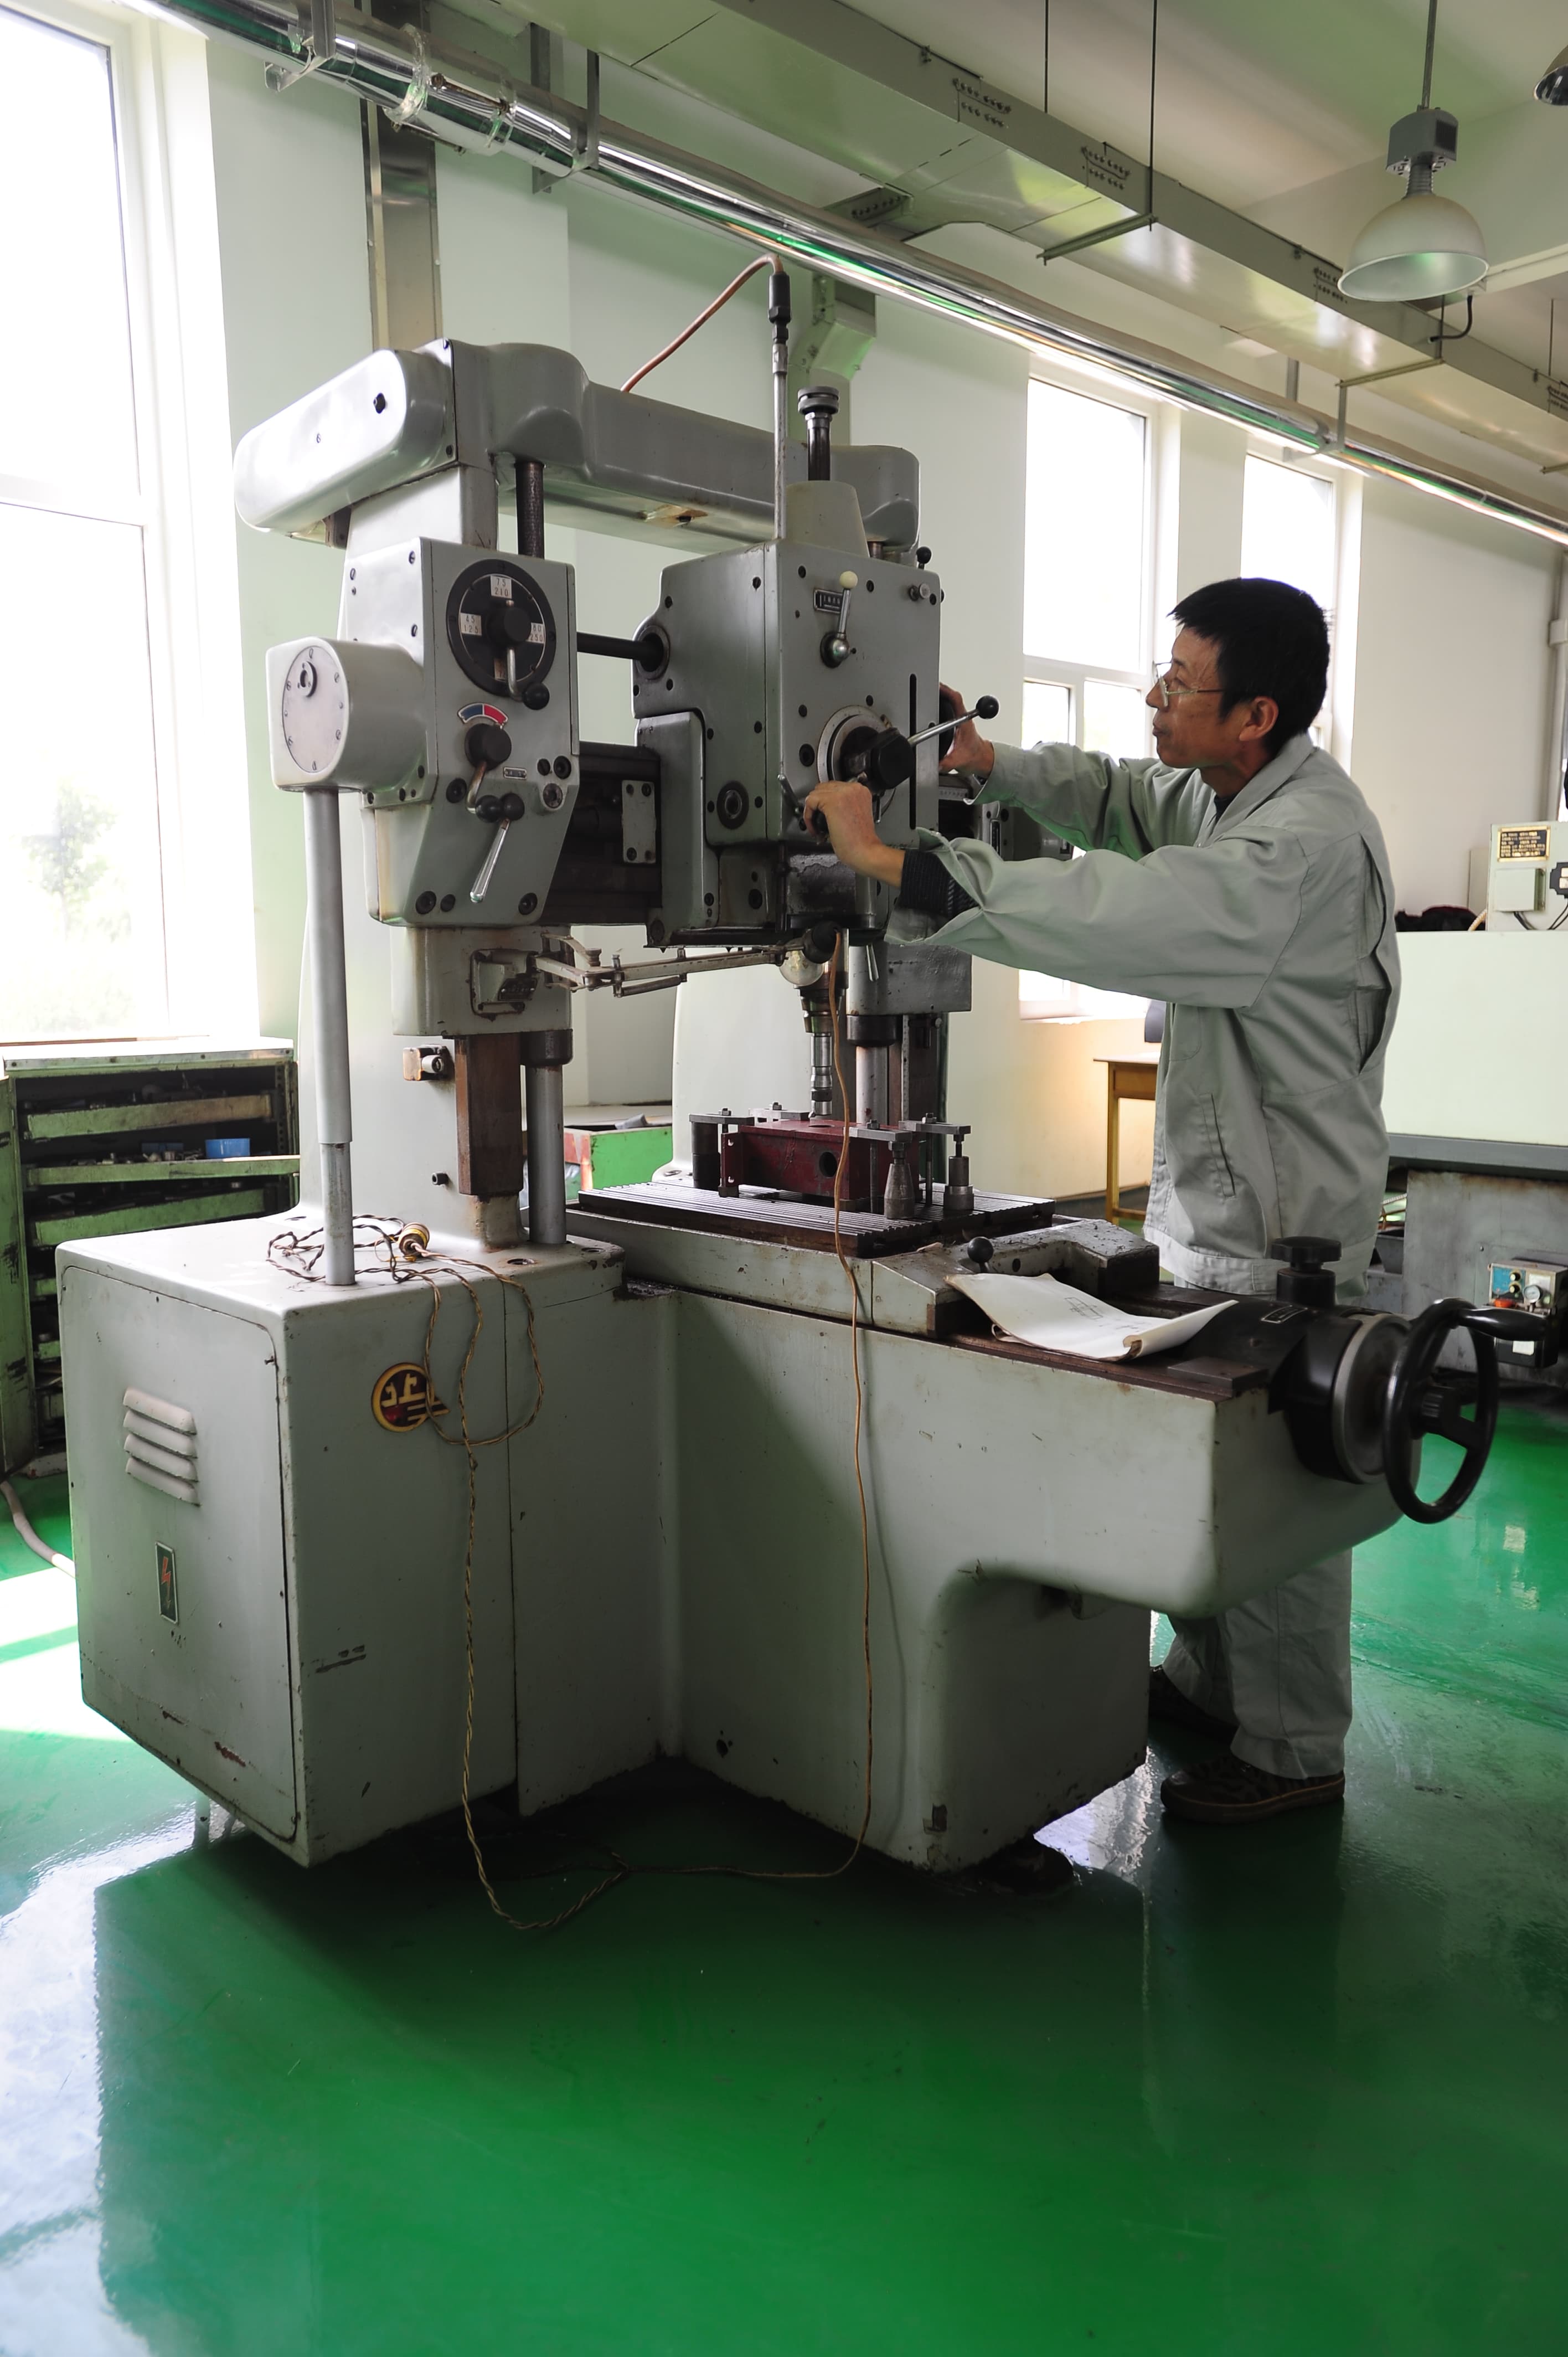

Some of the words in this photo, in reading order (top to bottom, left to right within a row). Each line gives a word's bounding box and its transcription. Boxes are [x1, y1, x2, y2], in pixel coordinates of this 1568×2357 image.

[496, 578, 506, 586] 75
[494, 586, 508, 596] 210
[466, 615, 475, 623] 45
[464, 625, 478, 634] 125
[530, 633, 543, 642] 250
